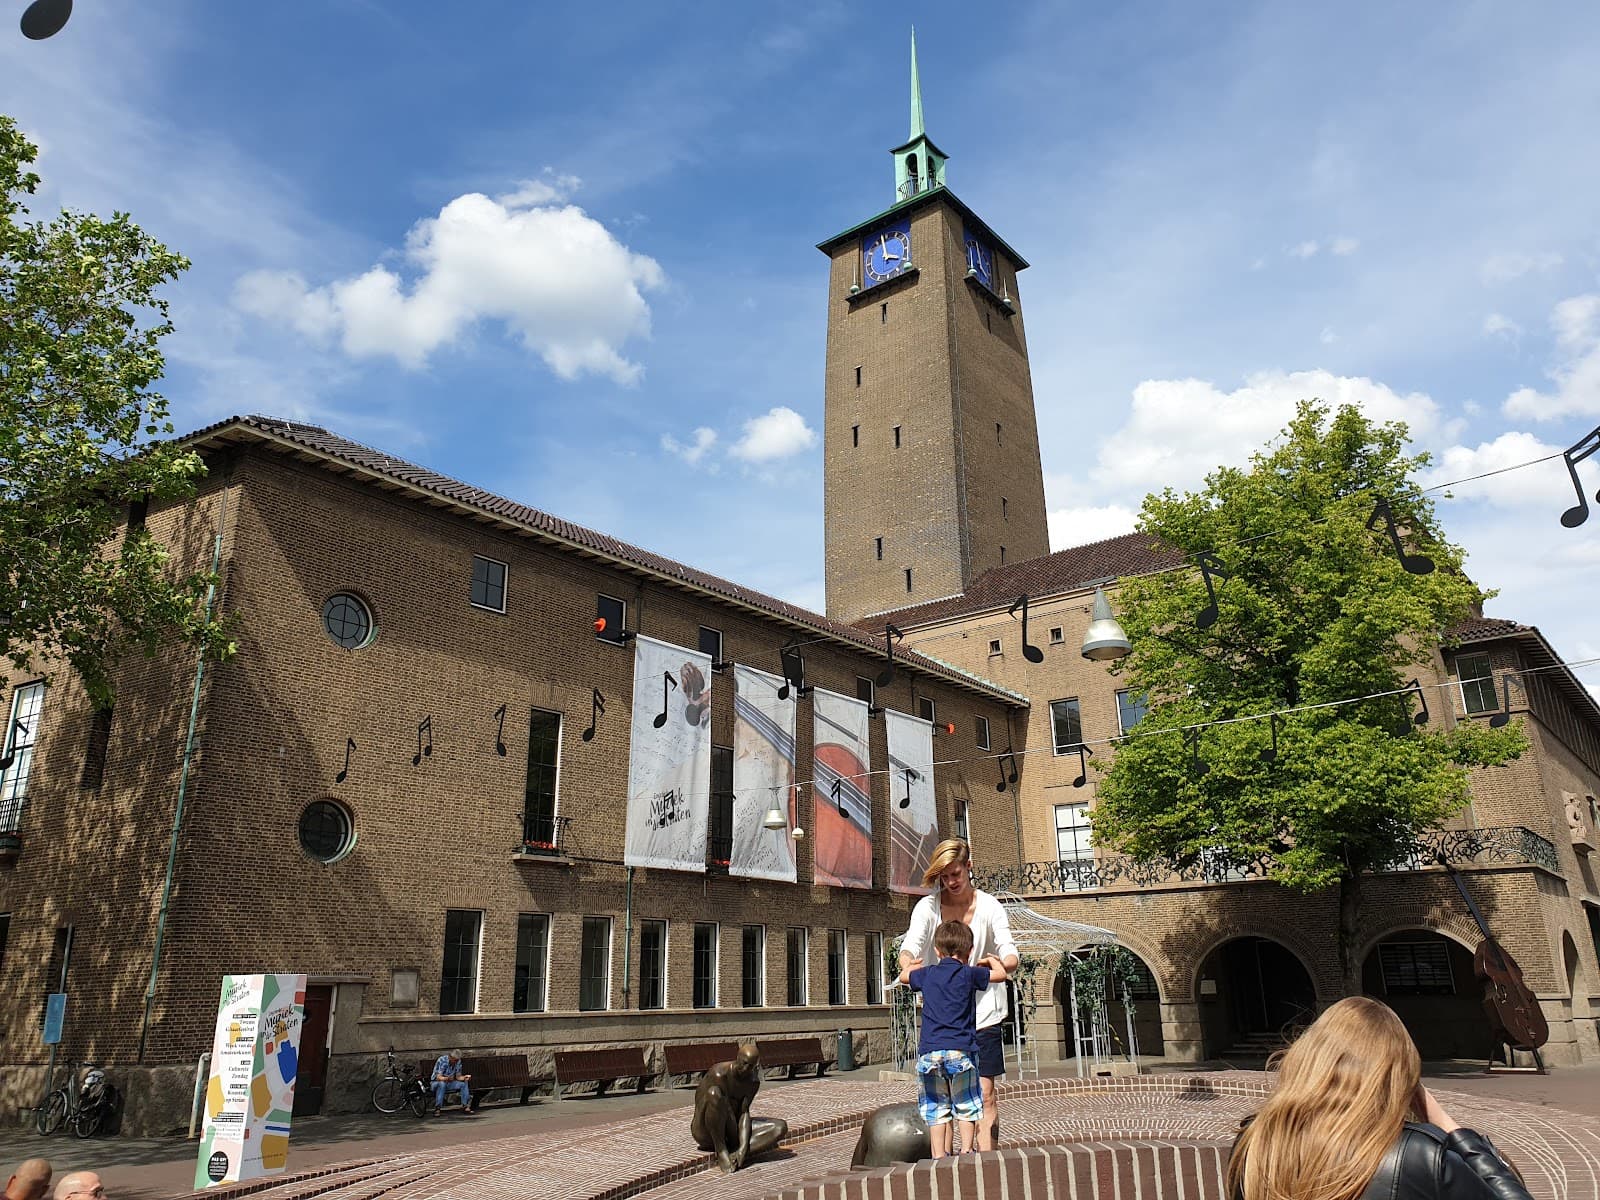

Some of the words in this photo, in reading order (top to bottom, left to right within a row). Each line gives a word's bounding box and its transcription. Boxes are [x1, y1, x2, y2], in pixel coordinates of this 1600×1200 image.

[650, 787, 685, 818] Muzek
[265, 1004, 294, 1030] Muziek
[273, 1018, 299, 1037] Straten
